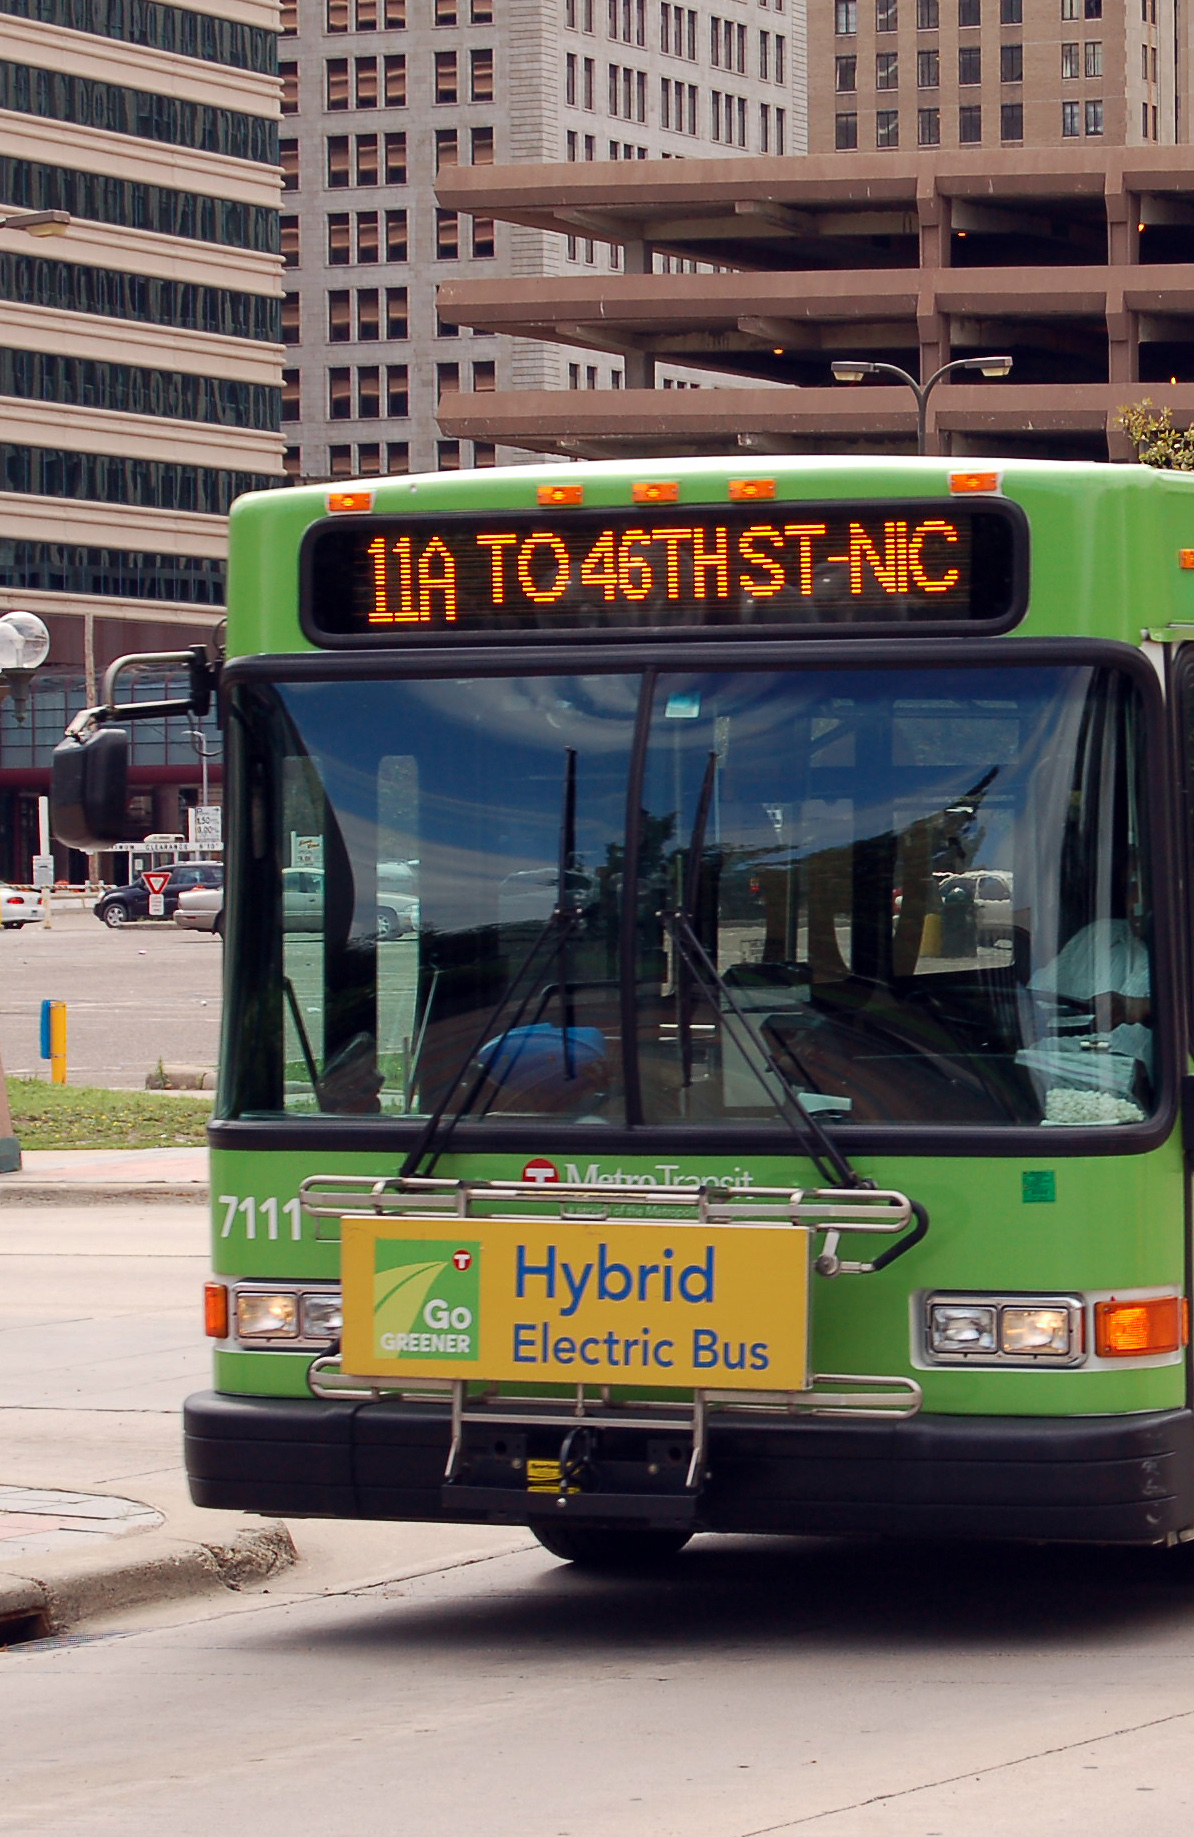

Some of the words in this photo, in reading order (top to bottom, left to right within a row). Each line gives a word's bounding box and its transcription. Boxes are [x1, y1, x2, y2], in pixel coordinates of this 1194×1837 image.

[367, 536, 456, 622] 11A
[218, 1195, 301, 1240] 7111
[515, 1243, 715, 1316] Hybrid
[423, 1298, 473, 1330] Go
[380, 1332, 470, 1353] GREENER
[512, 1321, 675, 1367] Electric
[692, 1328, 770, 1371] Bus
